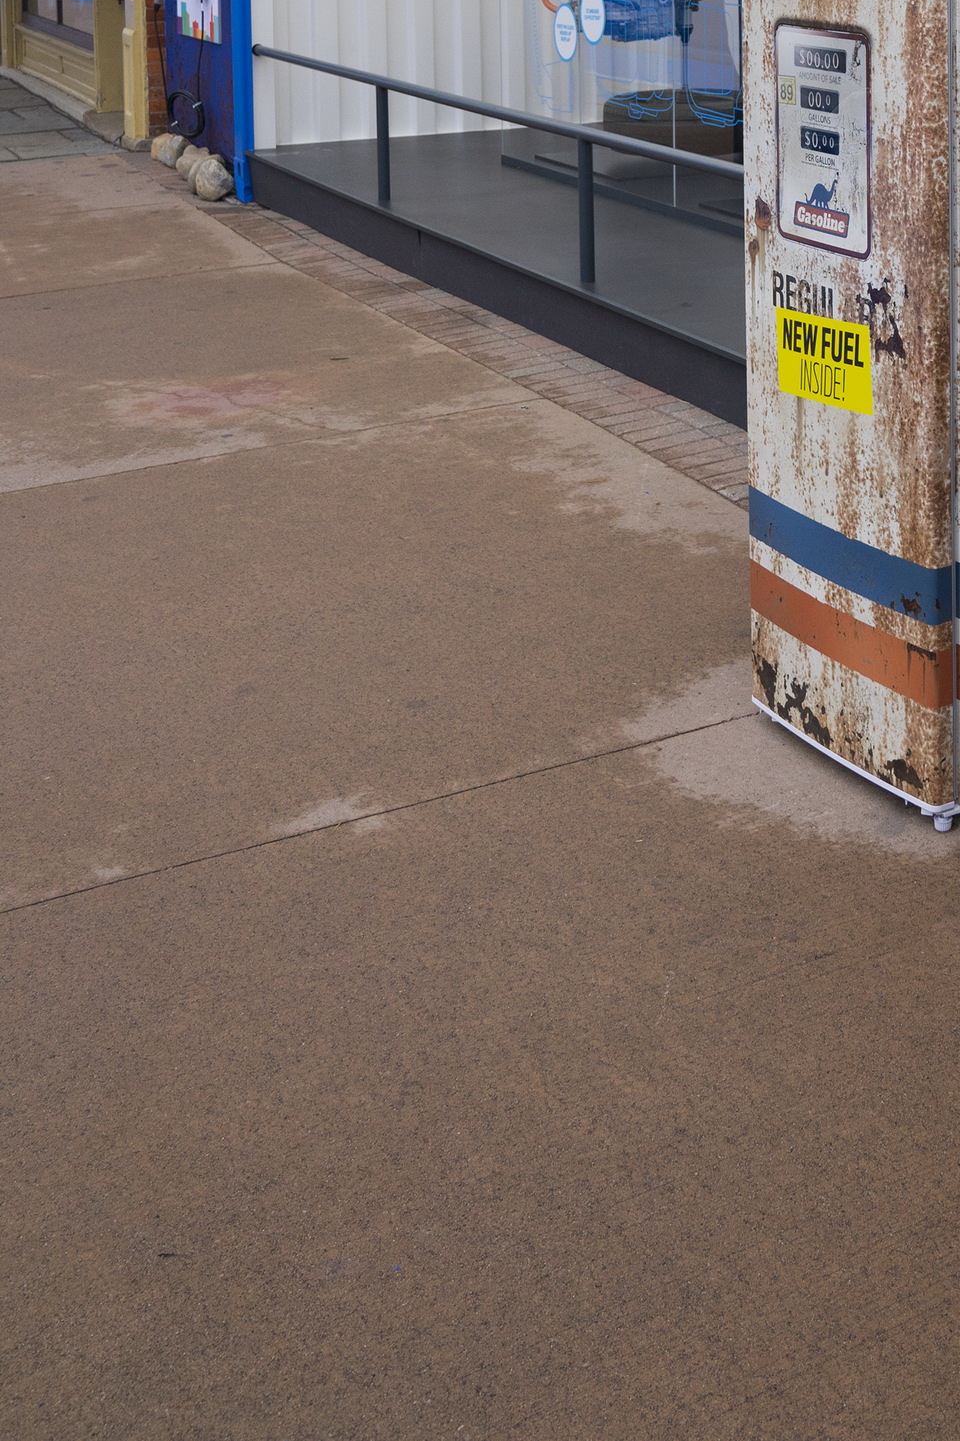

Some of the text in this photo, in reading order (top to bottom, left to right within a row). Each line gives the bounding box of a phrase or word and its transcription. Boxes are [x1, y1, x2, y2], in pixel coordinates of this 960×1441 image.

[799, 71, 820, 82] AMOUNT
[821, 74, 828, 83] OF
[829, 75, 842, 85] SALE
[780, 84, 794, 100] 89
[808, 113, 832, 124] GALLONS
[805, 153, 814, 162] PER
[814, 155, 836, 167] GALLON
[797, 206, 846, 233] Gasoline
[782, 318, 864, 368] NEW FUEL
[800, 358, 846, 402] INSIDE!
